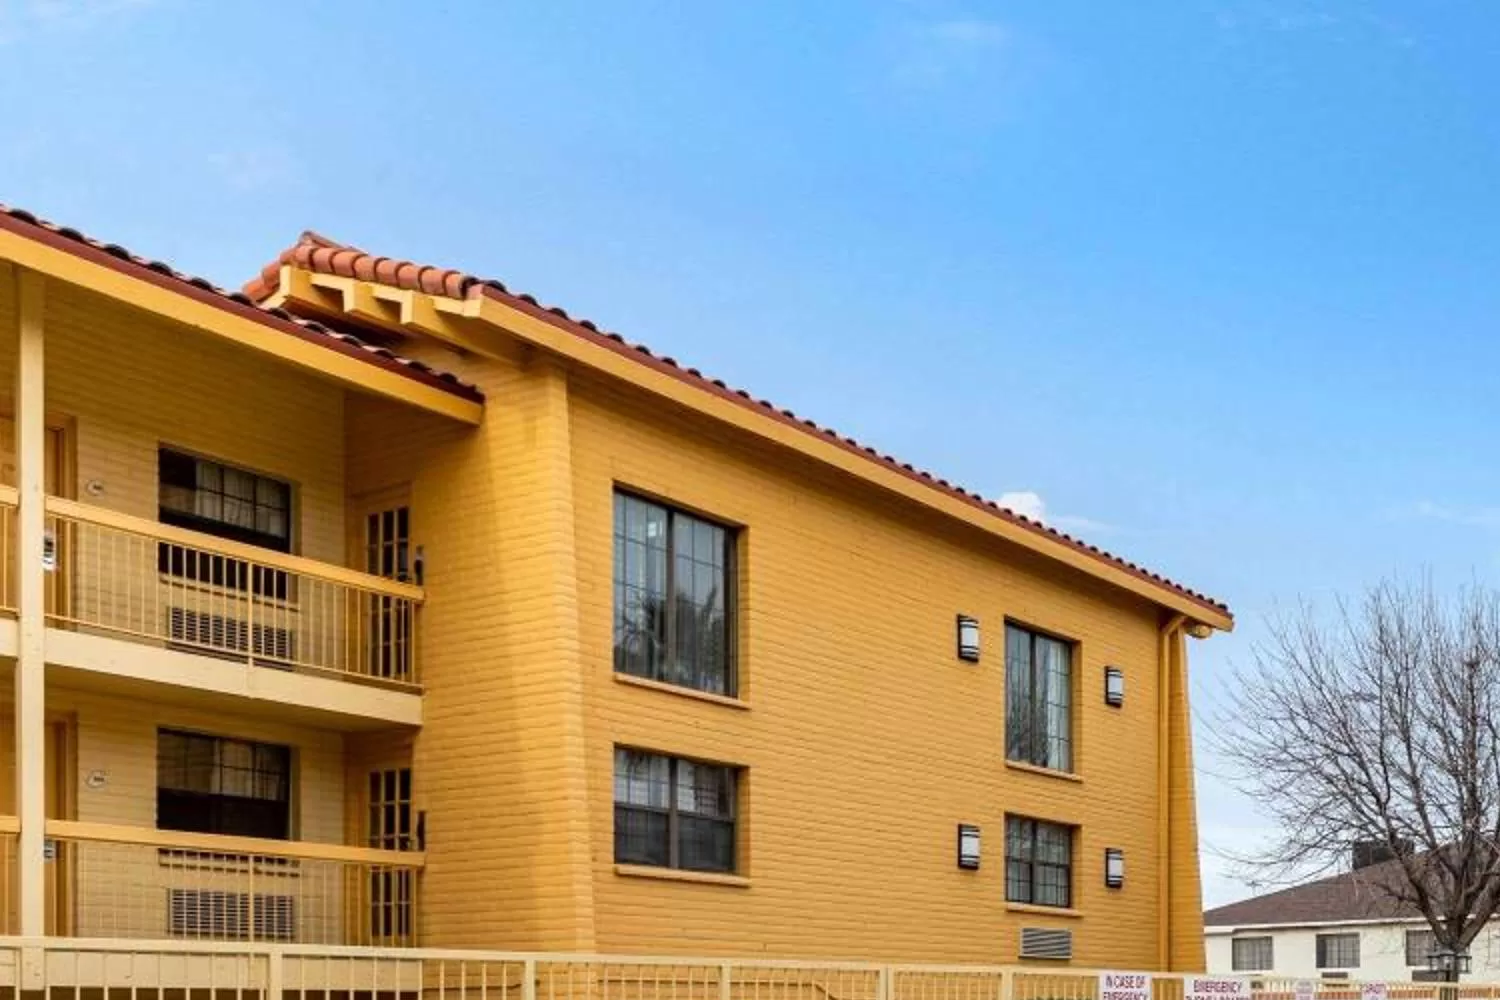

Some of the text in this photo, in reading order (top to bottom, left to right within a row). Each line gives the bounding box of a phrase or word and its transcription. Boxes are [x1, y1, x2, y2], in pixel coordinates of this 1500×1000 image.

[1105, 975, 1146, 989] IN CASE OF
[1193, 980, 1243, 993] EMERGENCY
